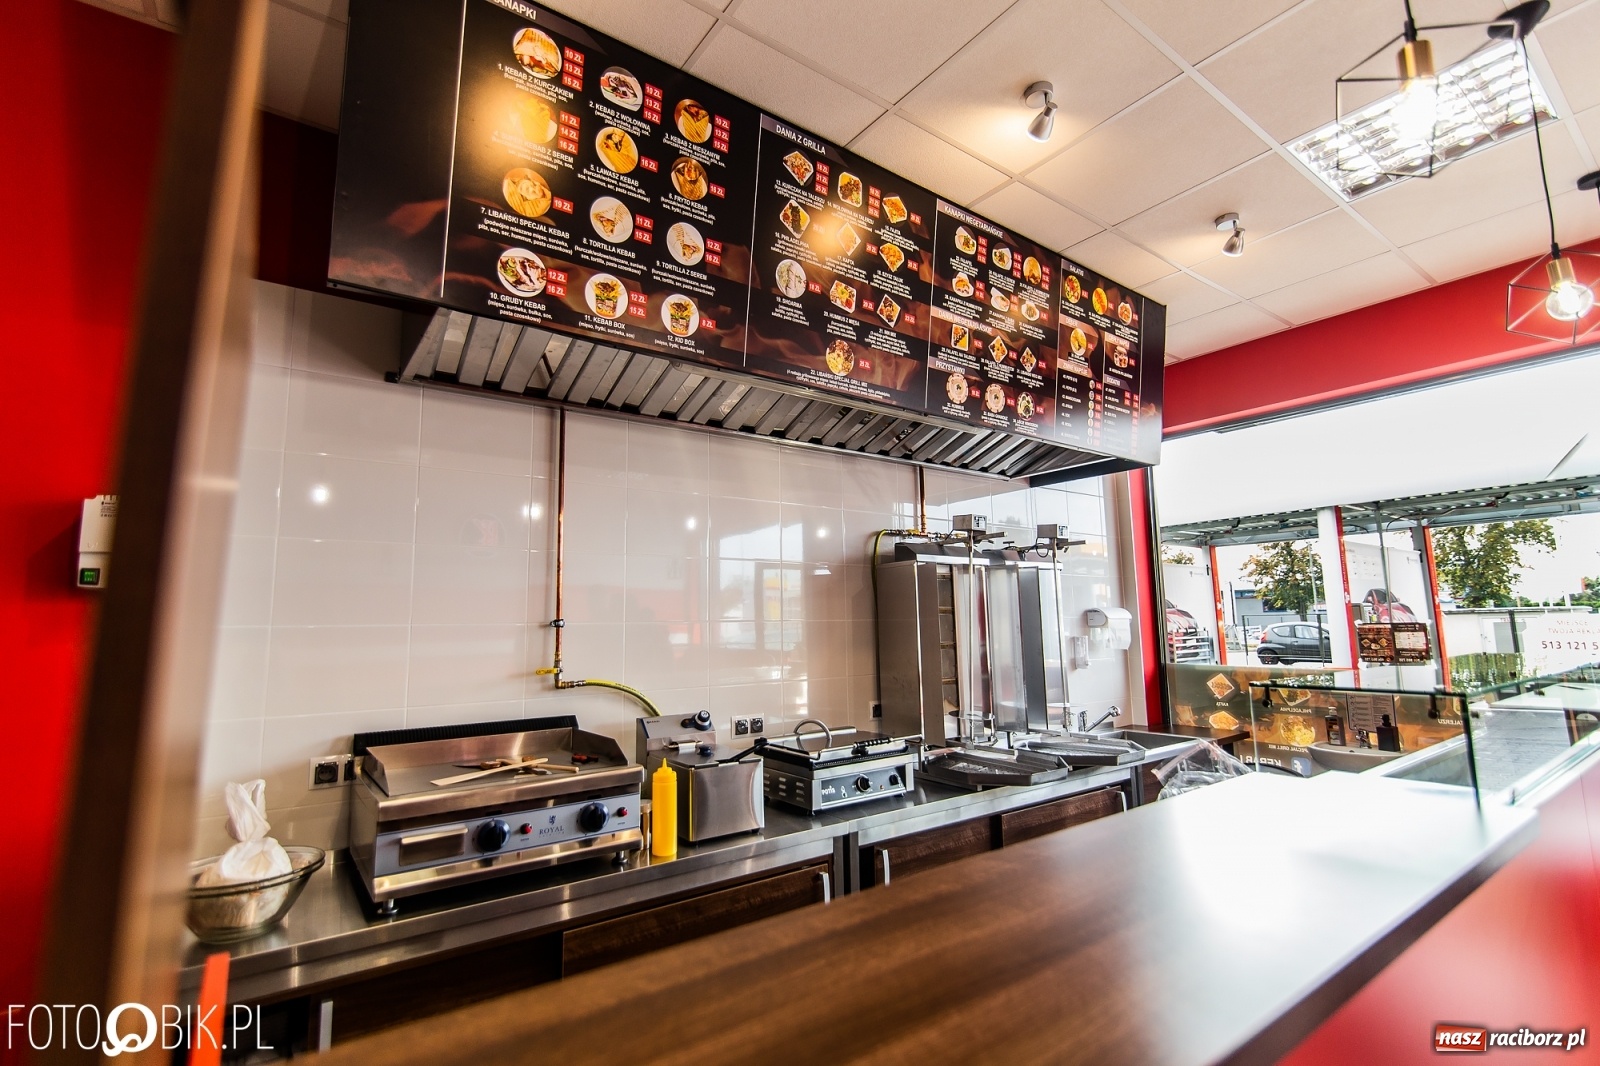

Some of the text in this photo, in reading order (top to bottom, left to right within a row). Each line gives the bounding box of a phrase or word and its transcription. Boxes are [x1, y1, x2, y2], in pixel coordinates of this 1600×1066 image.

[493, 0, 536, 20] ANAPKI
[574, 53, 582, 63] ZŁ
[573, 66, 582, 76] ZŁ
[504, 66, 527, 80] KEBAB
[533, 78, 573, 99] KURCZAKIEM
[572, 79, 581, 89] ZŁ
[589, 100, 594, 108] 2.
[595, 103, 615, 116] KEBAB
[653, 101, 660, 110] ZŁ
[561, 114, 577, 126] 11 ZŁ
[652, 113, 659, 122] ZŁ
[560, 127, 577, 139] 14 ZŁ
[776, 124, 825, 155] DANIA Z GRILLA
[524, 139, 546, 153] KEBAB
[552, 150, 573, 163] SEREM
[567, 143, 576, 152] ZŁ
[649, 161, 656, 170] ZŁ
[596, 166, 619, 179] LAWASZ
[619, 174, 638, 186] KEBAB
[554, 199, 571, 211] 19 ZŁ
[488, 208, 518, 223] LIBAŃSKI
[519, 218, 547, 232] SPECJAŁ
[548, 227, 569, 239] KEBAB
[644, 219, 651, 227] ZŁ
[635, 230, 650, 241] 15 ZŁ
[589, 239, 616, 252] TORTILLA
[616, 248, 635, 258] KEBAB
[661, 261, 685, 274] TORTILLA
[548, 271, 566, 282] 12 ZŁ
[547, 284, 565, 295] 16 ZŁ
[500, 294, 523, 305] GRUBY
[523, 300, 545, 311] KEBAB
[638, 295, 646, 303] ZŁ
[637, 308, 645, 316] ZŁ
[592, 316, 612, 326] KEBAB
[613, 321, 625, 329] BOX
[1541, 640, 1562, 650] 513
[1567, 642, 1586, 650] 121
[539, 826, 564, 834] ROYAL
